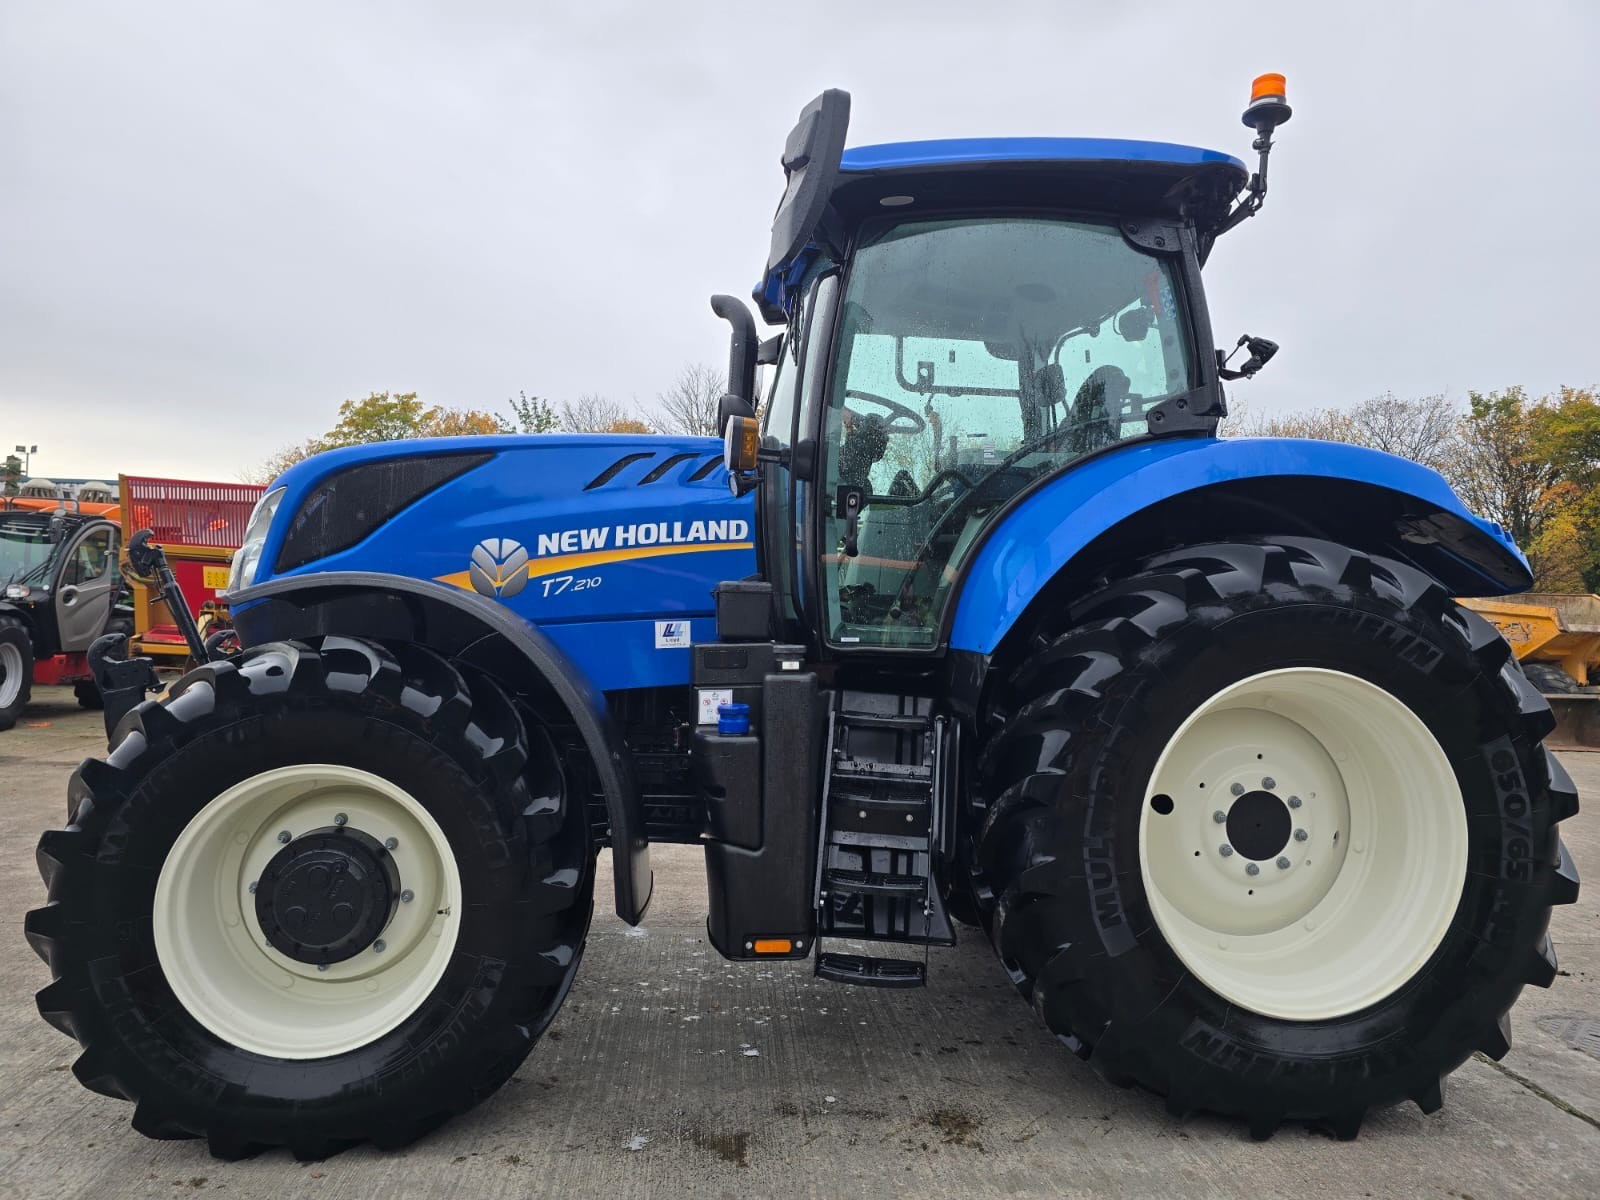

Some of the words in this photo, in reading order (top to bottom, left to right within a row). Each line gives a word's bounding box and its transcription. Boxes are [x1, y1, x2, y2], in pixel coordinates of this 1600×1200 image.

[538, 527, 610, 556] NEW
[615, 519, 749, 547] HOLLAND
[541, 575, 602, 598] T7.210
